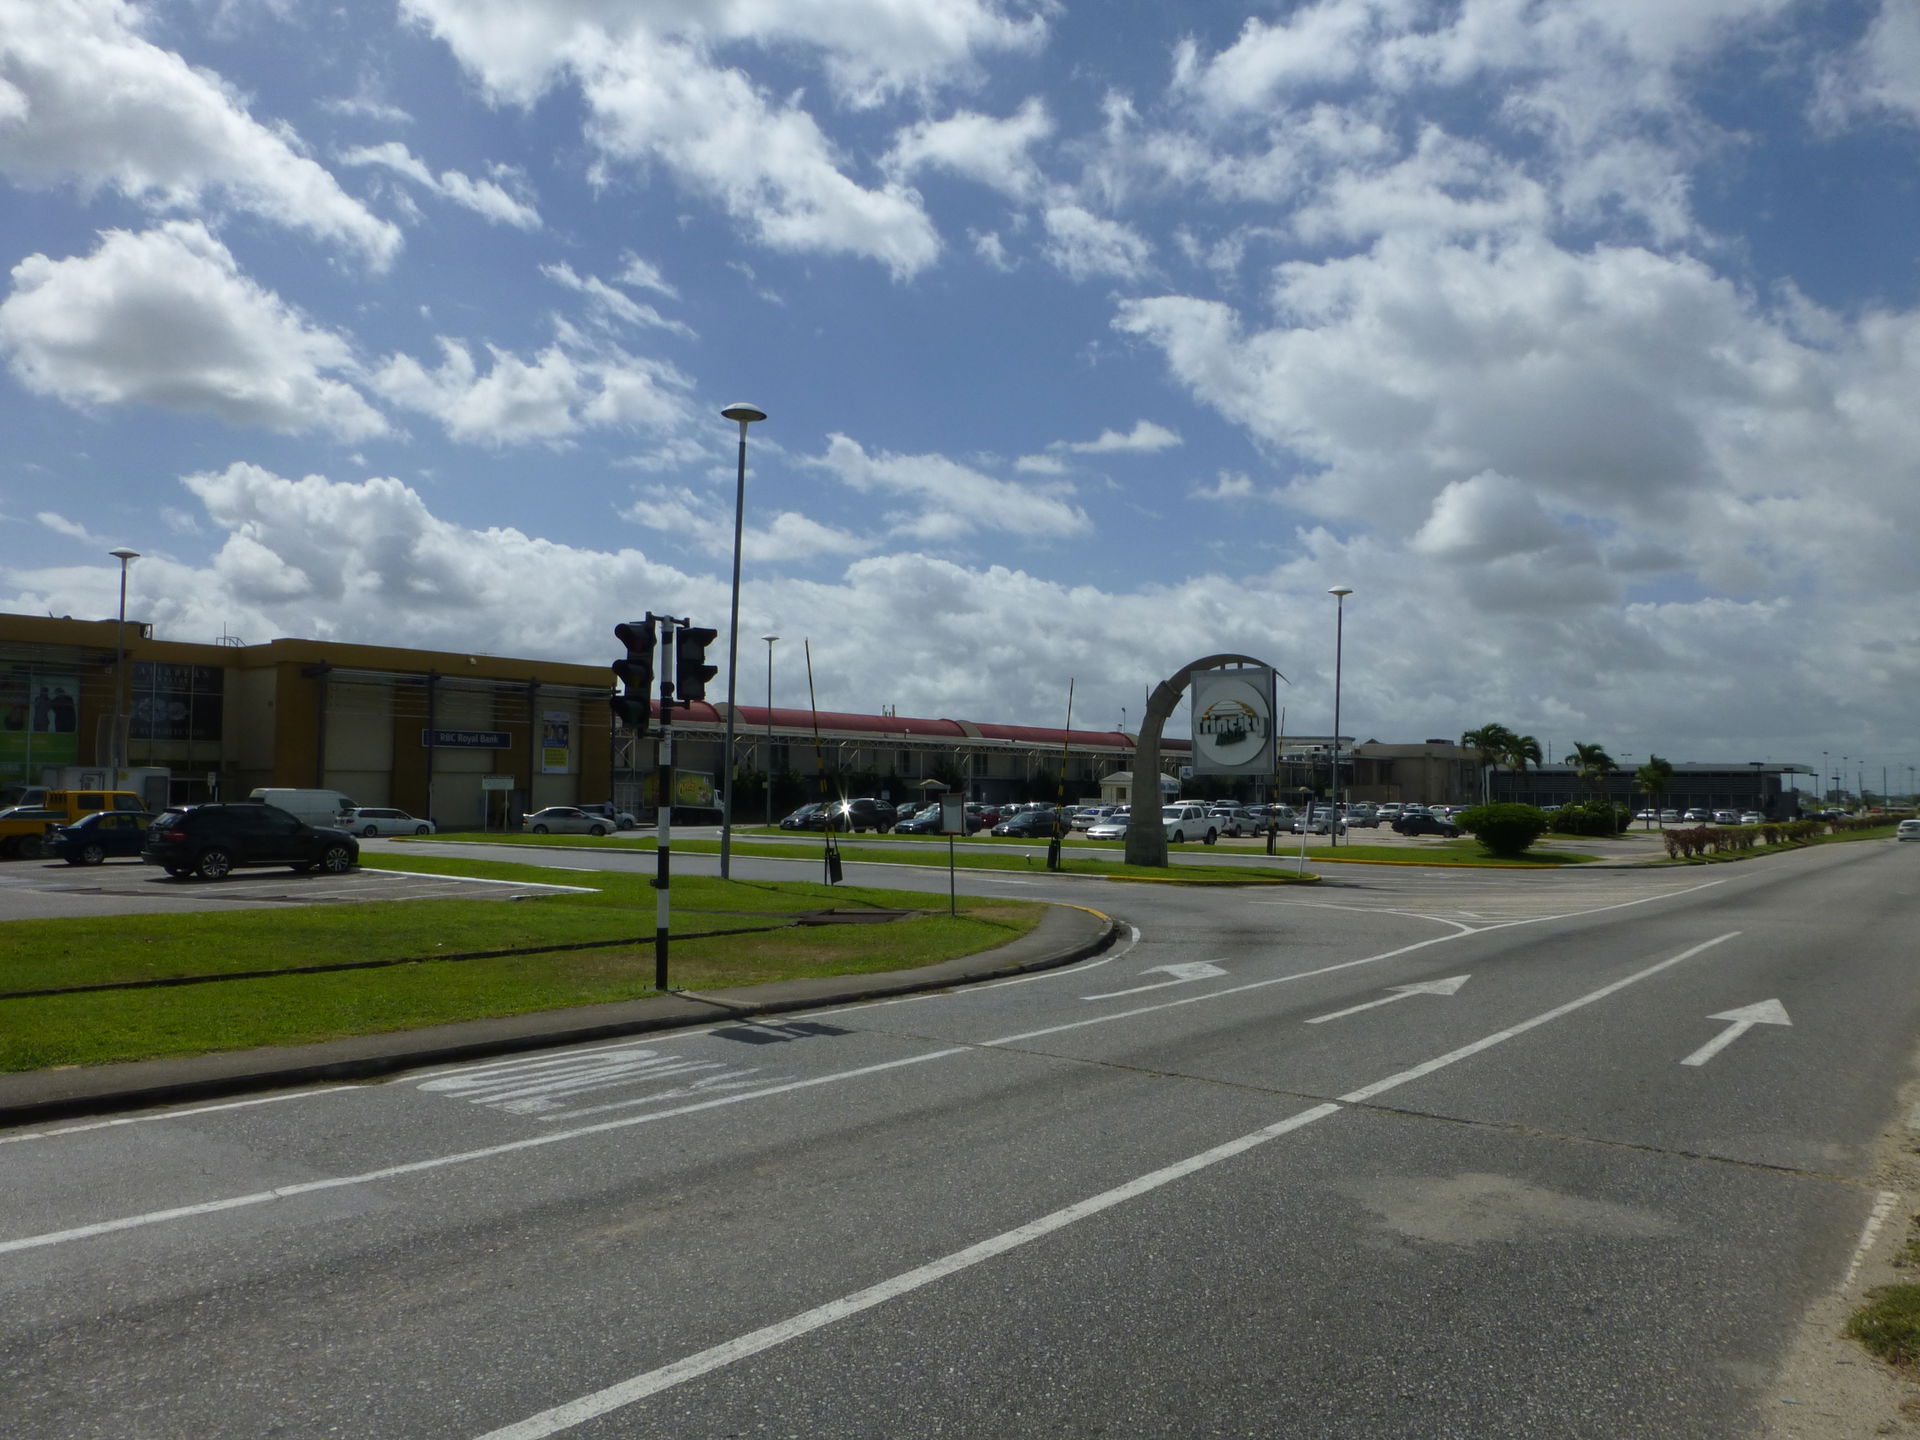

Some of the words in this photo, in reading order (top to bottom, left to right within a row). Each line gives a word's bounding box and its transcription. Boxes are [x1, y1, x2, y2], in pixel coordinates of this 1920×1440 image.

[439, 732, 456, 742] RBC
[457, 733, 479, 745] Royal
[480, 734, 499, 744] Bank
